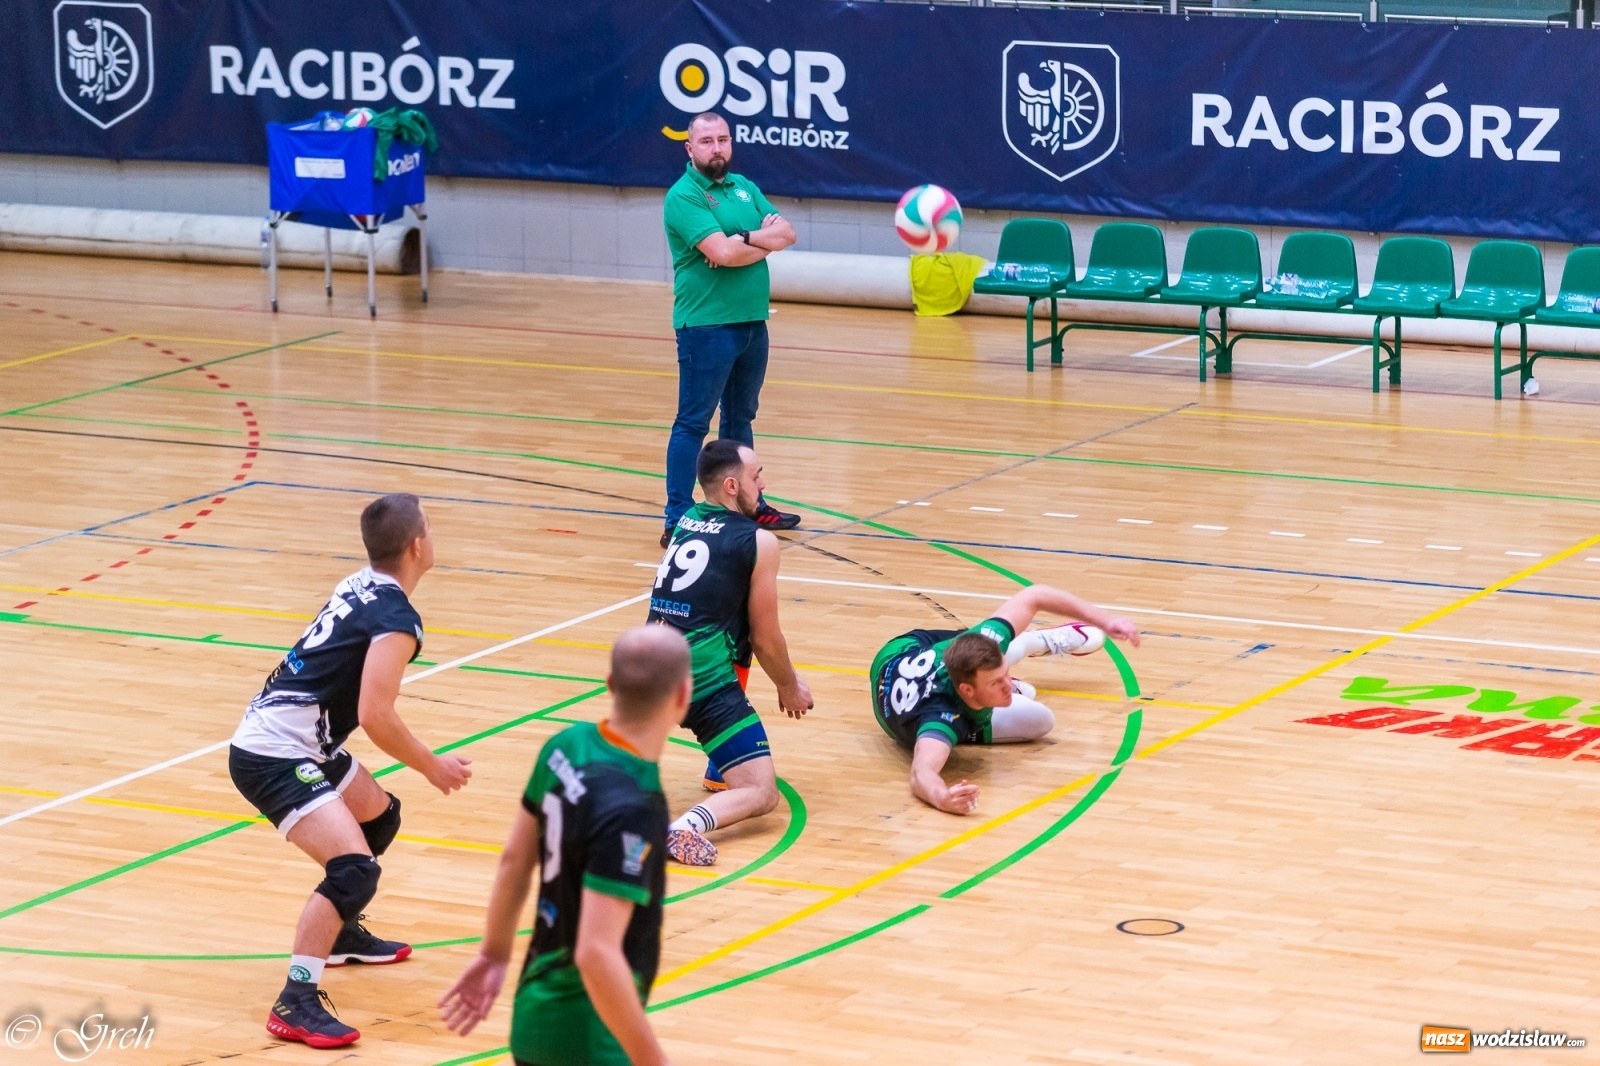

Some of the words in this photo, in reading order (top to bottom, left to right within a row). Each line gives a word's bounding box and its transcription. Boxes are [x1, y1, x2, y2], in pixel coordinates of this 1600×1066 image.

[209, 36, 516, 110] RACIBÓRZ
[735, 123, 849, 151] RACIBÓRZ
[1191, 83, 1561, 162] RACIBÓRZ
[655, 537, 710, 592] 49
